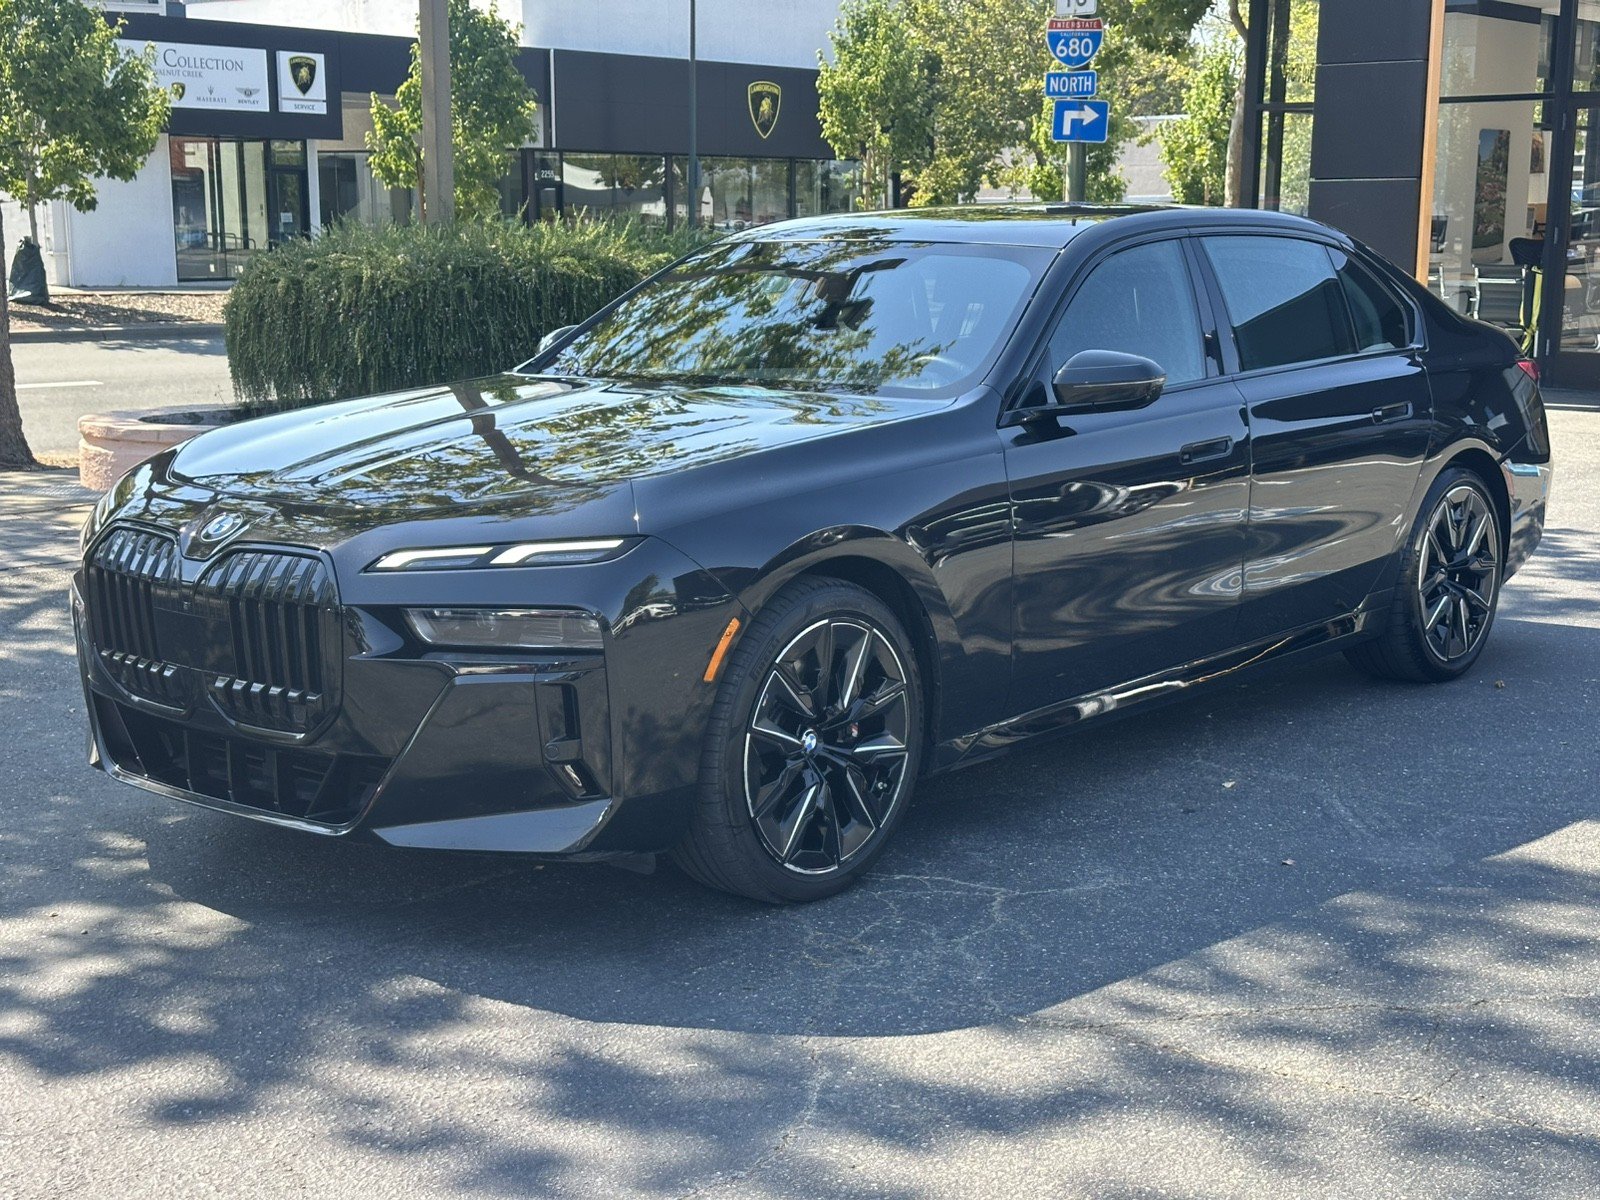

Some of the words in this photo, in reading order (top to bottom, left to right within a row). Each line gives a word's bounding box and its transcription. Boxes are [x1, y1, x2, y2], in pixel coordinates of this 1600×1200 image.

[1052, 21, 1098, 29] INTERSTATE
[1055, 37, 1093, 57] 680
[163, 48, 244, 72] COLLECTION
[155, 68, 181, 77] ALNUT
[182, 70, 204, 78] CREEK
[1049, 75, 1092, 92] NORTH
[294, 103, 316, 111] SERVICE
